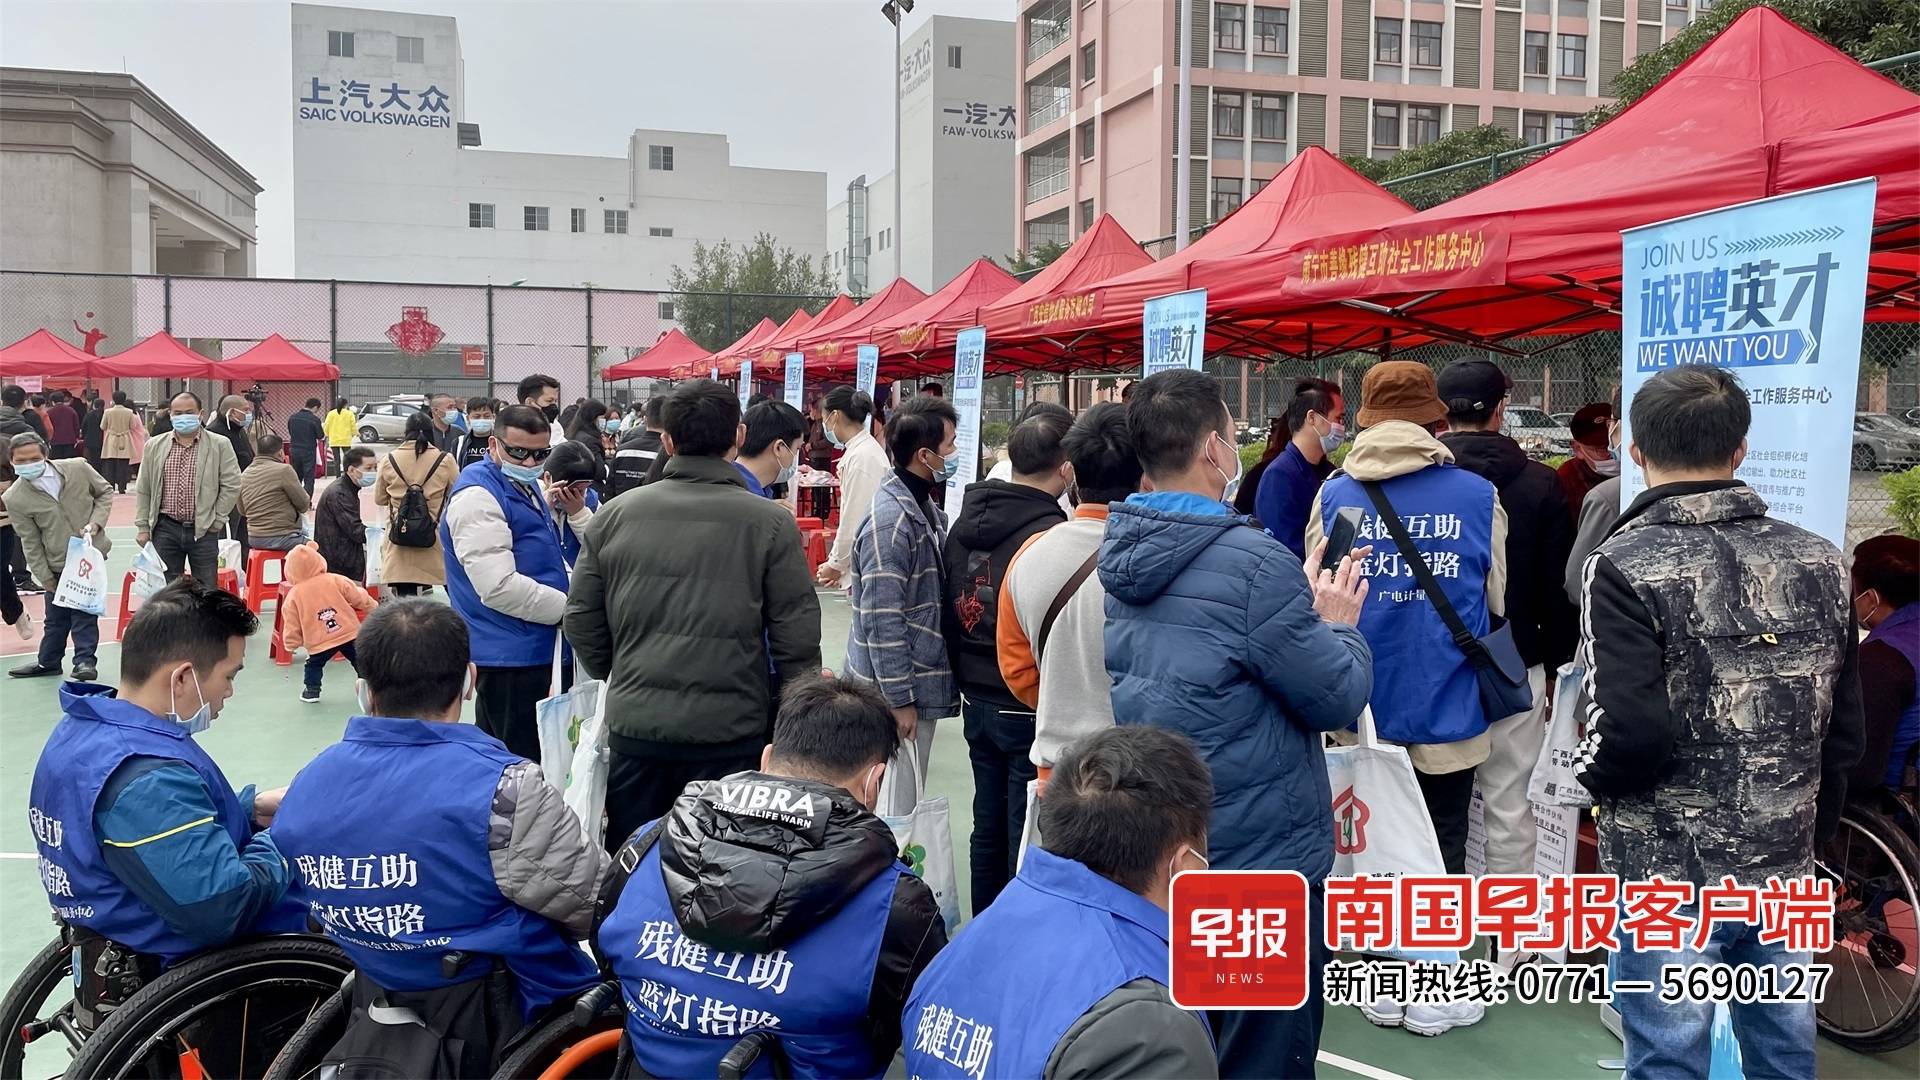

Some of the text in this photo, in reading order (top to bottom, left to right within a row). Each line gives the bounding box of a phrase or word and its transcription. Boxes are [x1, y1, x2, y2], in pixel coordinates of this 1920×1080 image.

[300, 77, 450, 113] 上汽大众
[300, 107, 450, 128] SAIC VOLKSWAGEN
[1641, 235, 1718, 270] JOIN US
[1640, 251, 1840, 364] 诚聘英才
[1640, 333, 1789, 367] WE WANT YOU
[721, 783, 815, 817] VIBRA
[780, 814, 812, 828] WARN
[40, 855, 74, 897] 灯指路
